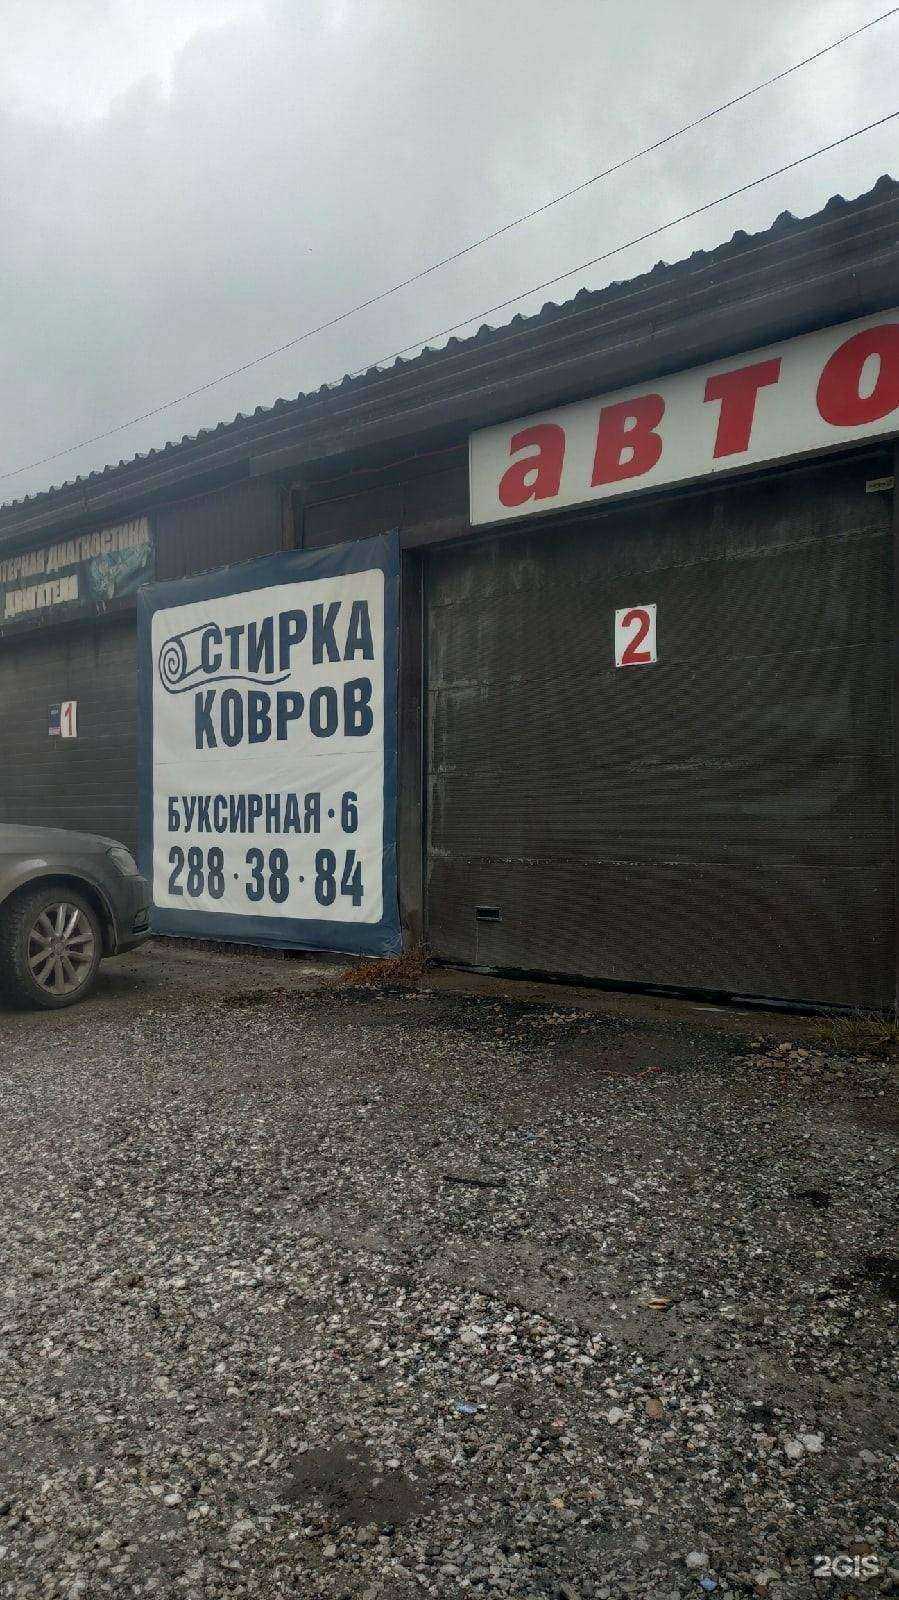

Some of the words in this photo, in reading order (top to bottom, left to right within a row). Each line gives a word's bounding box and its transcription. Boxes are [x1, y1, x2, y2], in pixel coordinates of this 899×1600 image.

[201, 600, 374, 674] СТИРКА
[621, 608, 652, 665] 2
[195, 677, 373, 750] КОВРОВ
